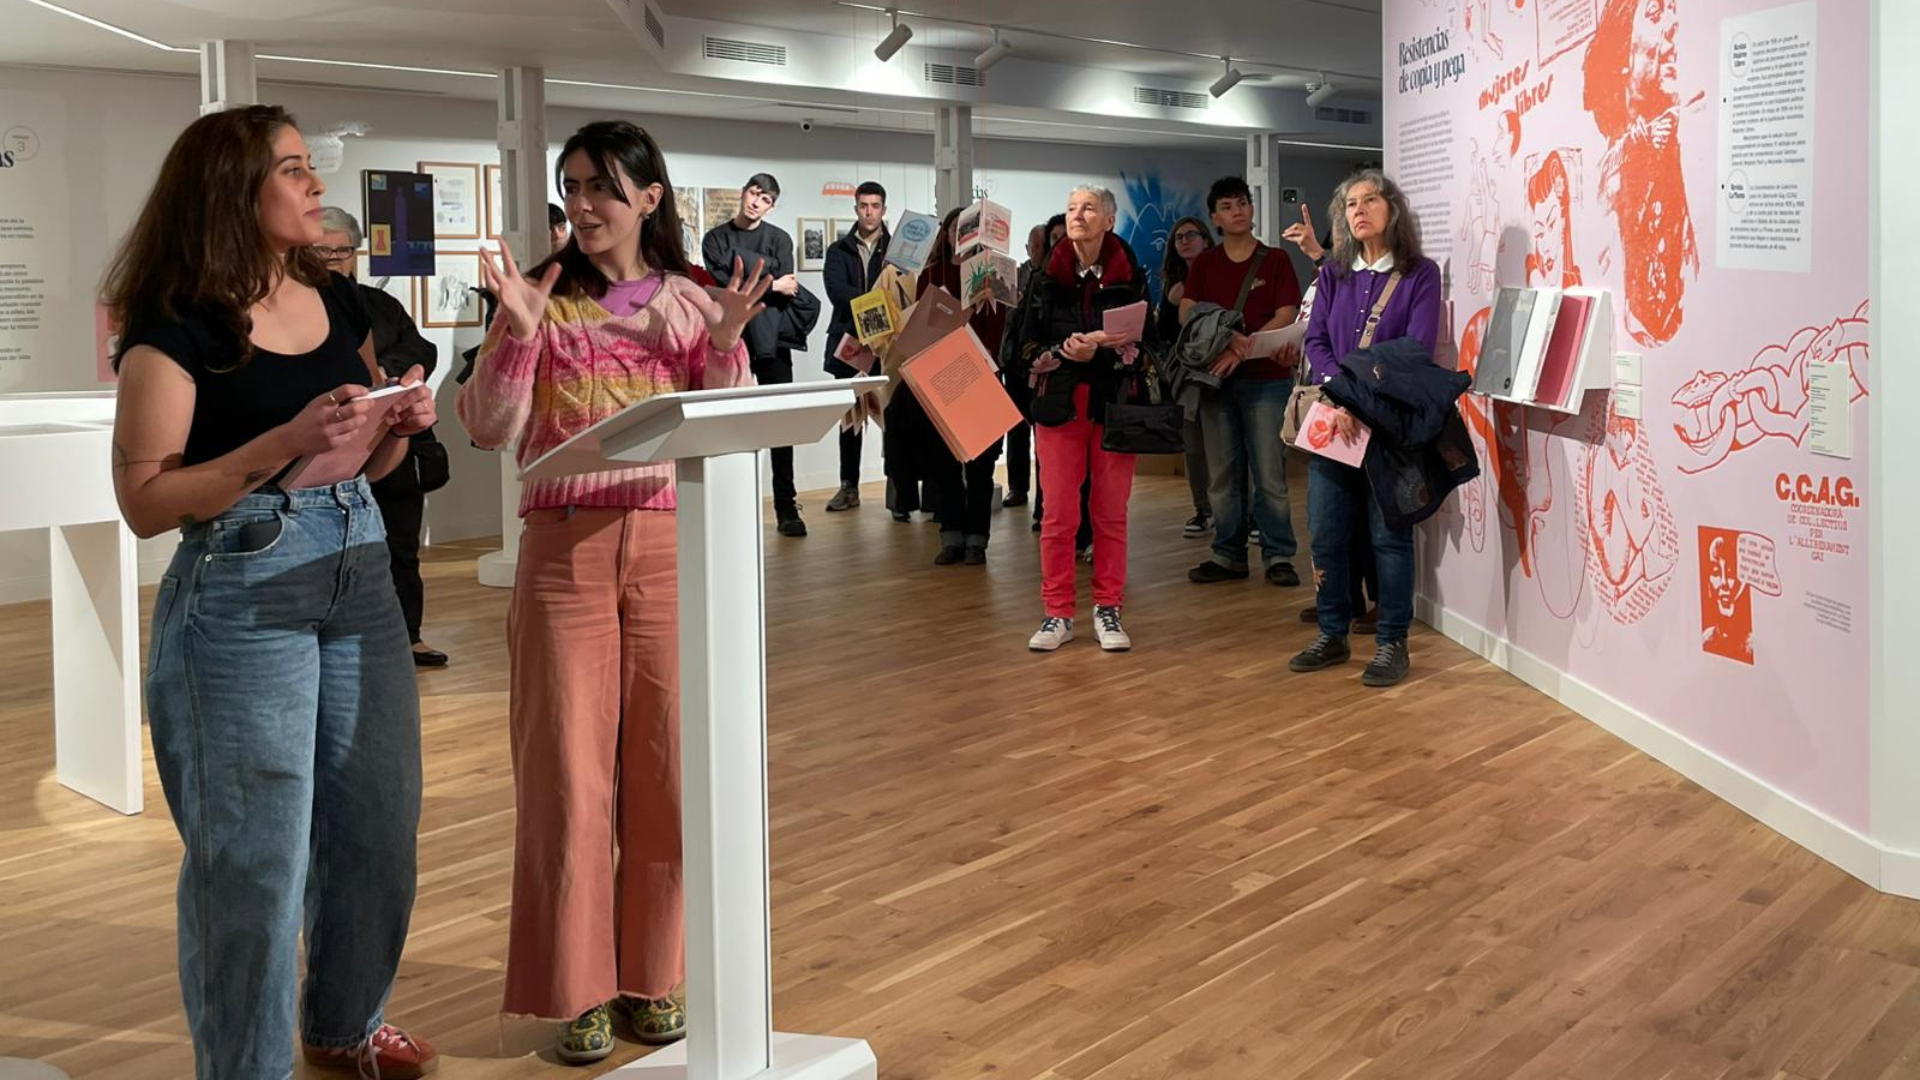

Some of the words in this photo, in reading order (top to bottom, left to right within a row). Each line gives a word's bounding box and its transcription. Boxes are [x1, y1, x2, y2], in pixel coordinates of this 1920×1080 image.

[1399, 26, 1449, 67] Resistencias
[1399, 68, 1408, 94] de
[1410, 60, 1433, 94] copia
[1434, 61, 1441, 89] y
[1442, 53, 1465, 87] pega
[1478, 59, 1530, 111] mujeres
[1515, 73, 1553, 116] libres
[1775, 473, 1860, 508] C.C.A.G.
